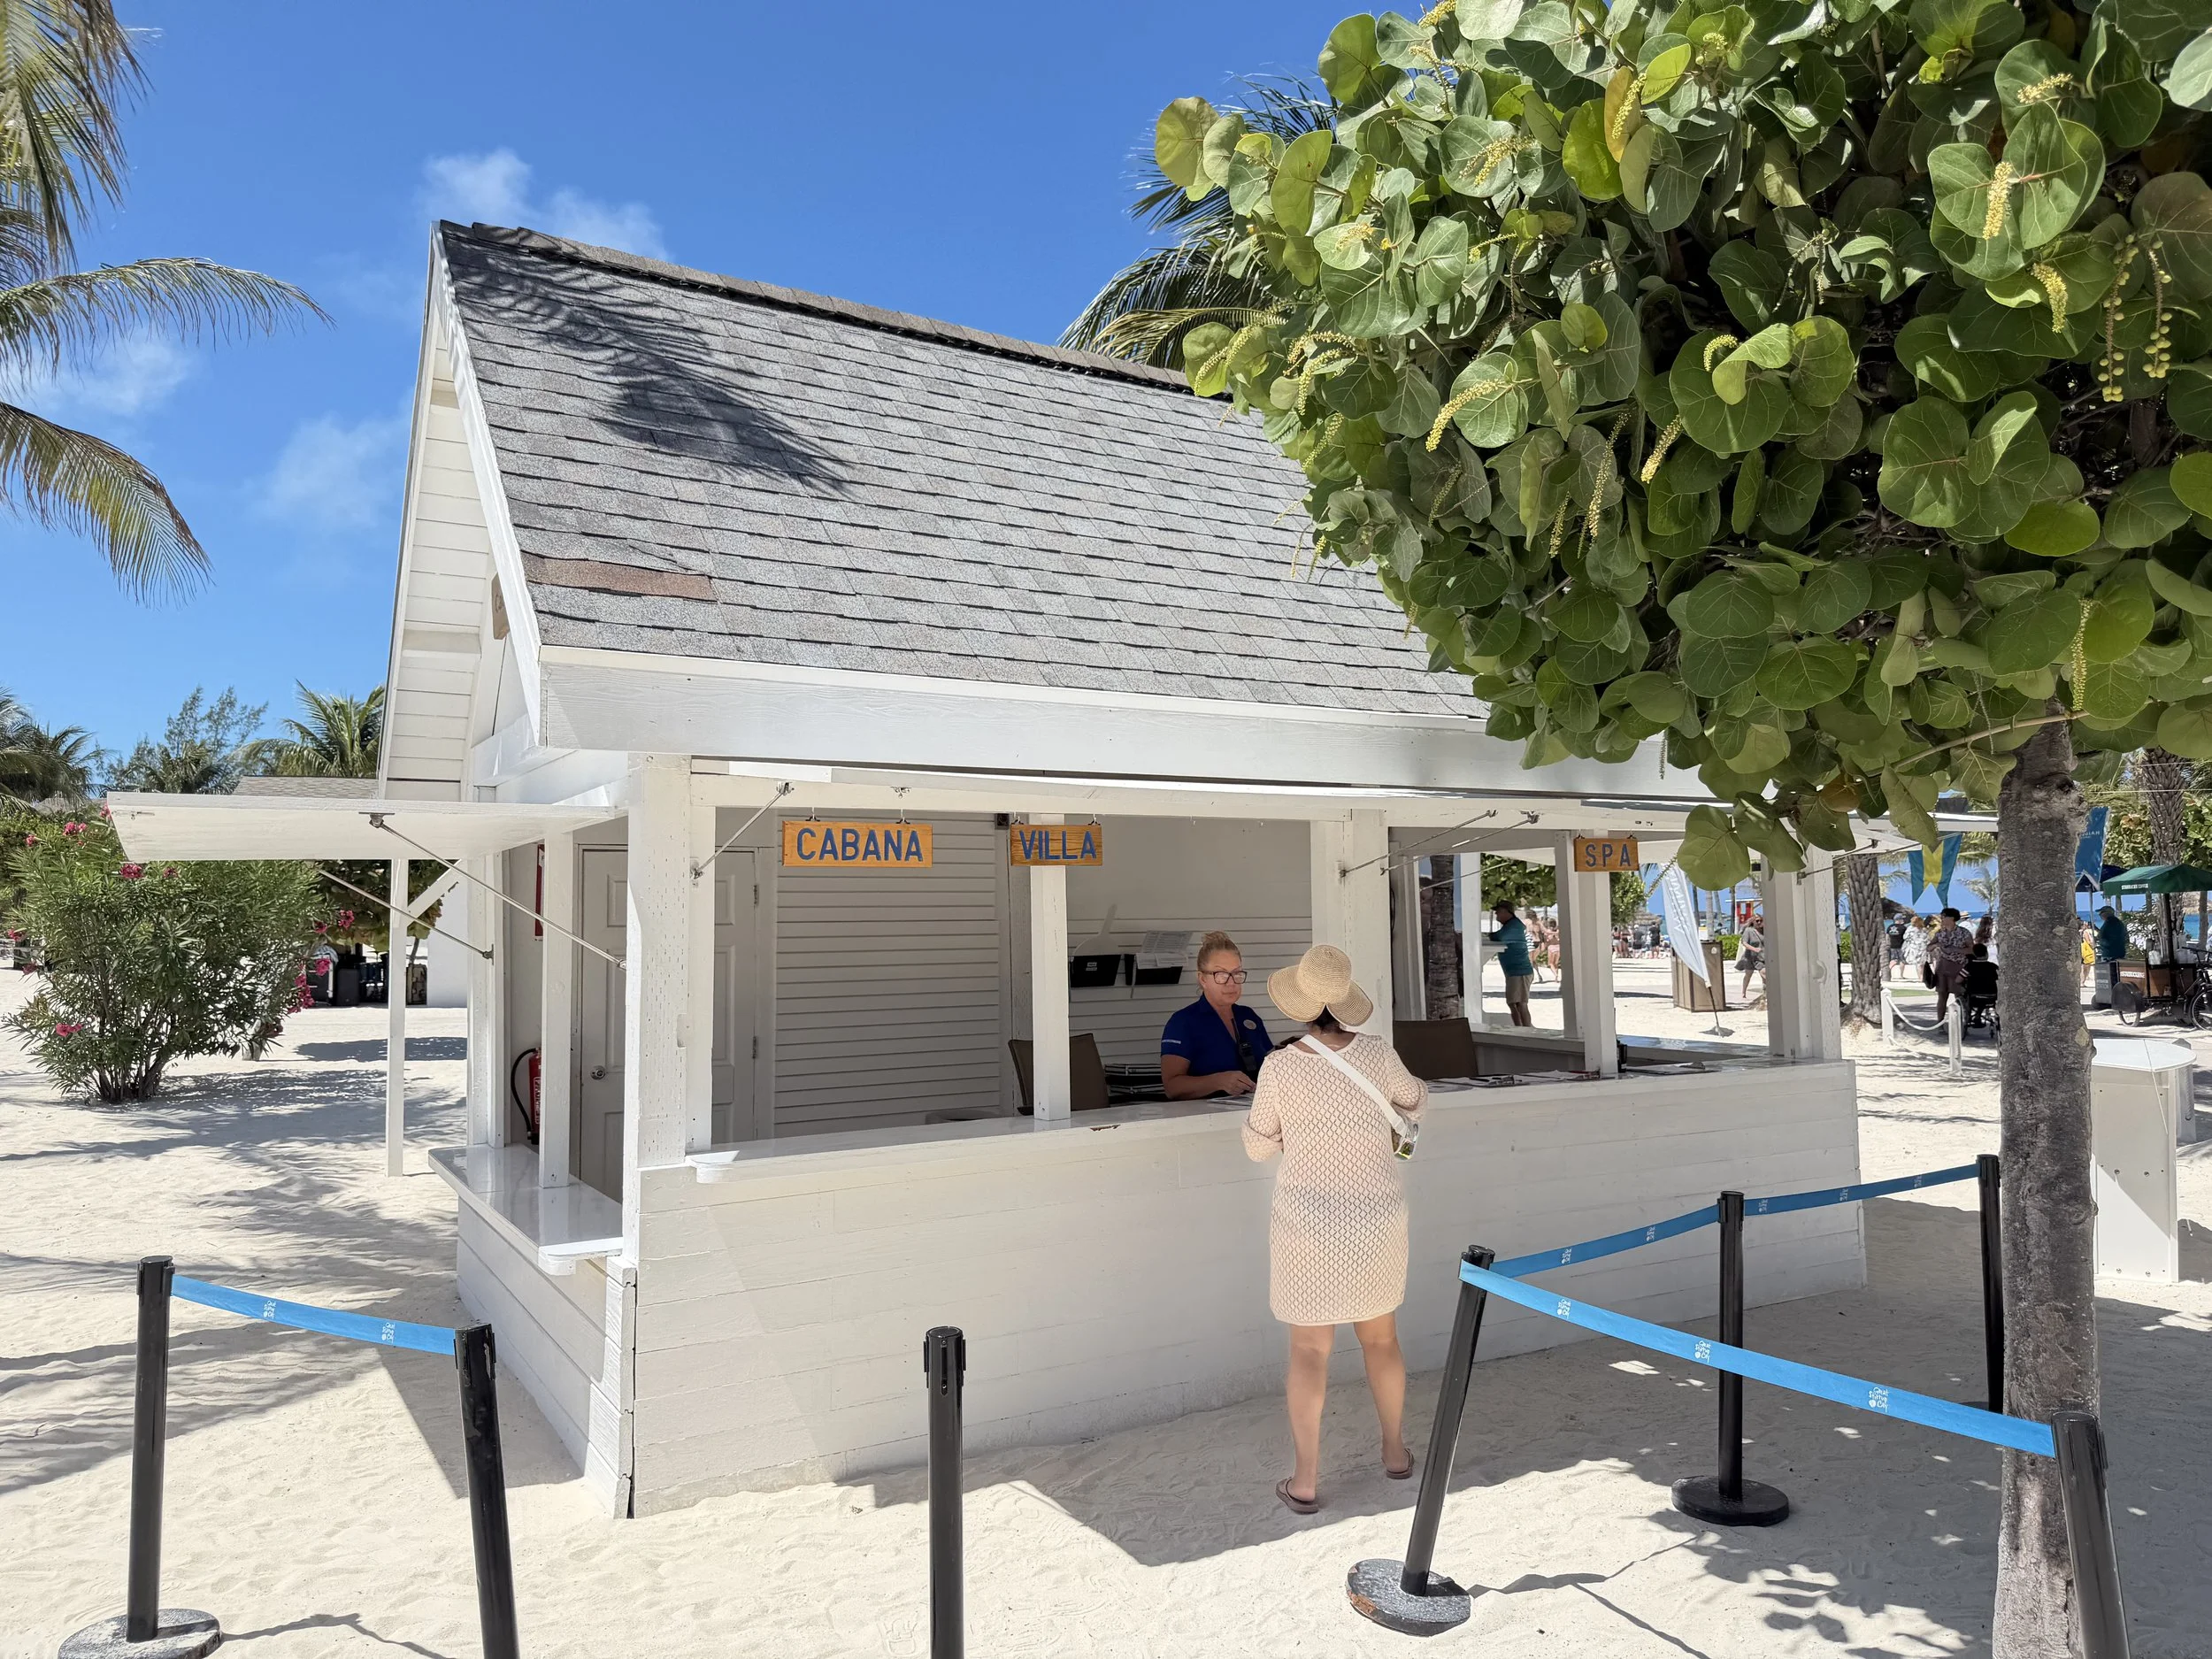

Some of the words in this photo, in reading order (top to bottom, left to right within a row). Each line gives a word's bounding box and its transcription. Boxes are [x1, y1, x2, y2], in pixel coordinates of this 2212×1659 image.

[796, 827, 924, 863] CABANA
[1018, 829, 1097, 860] VILLA
[1585, 843, 1632, 868] SPA
